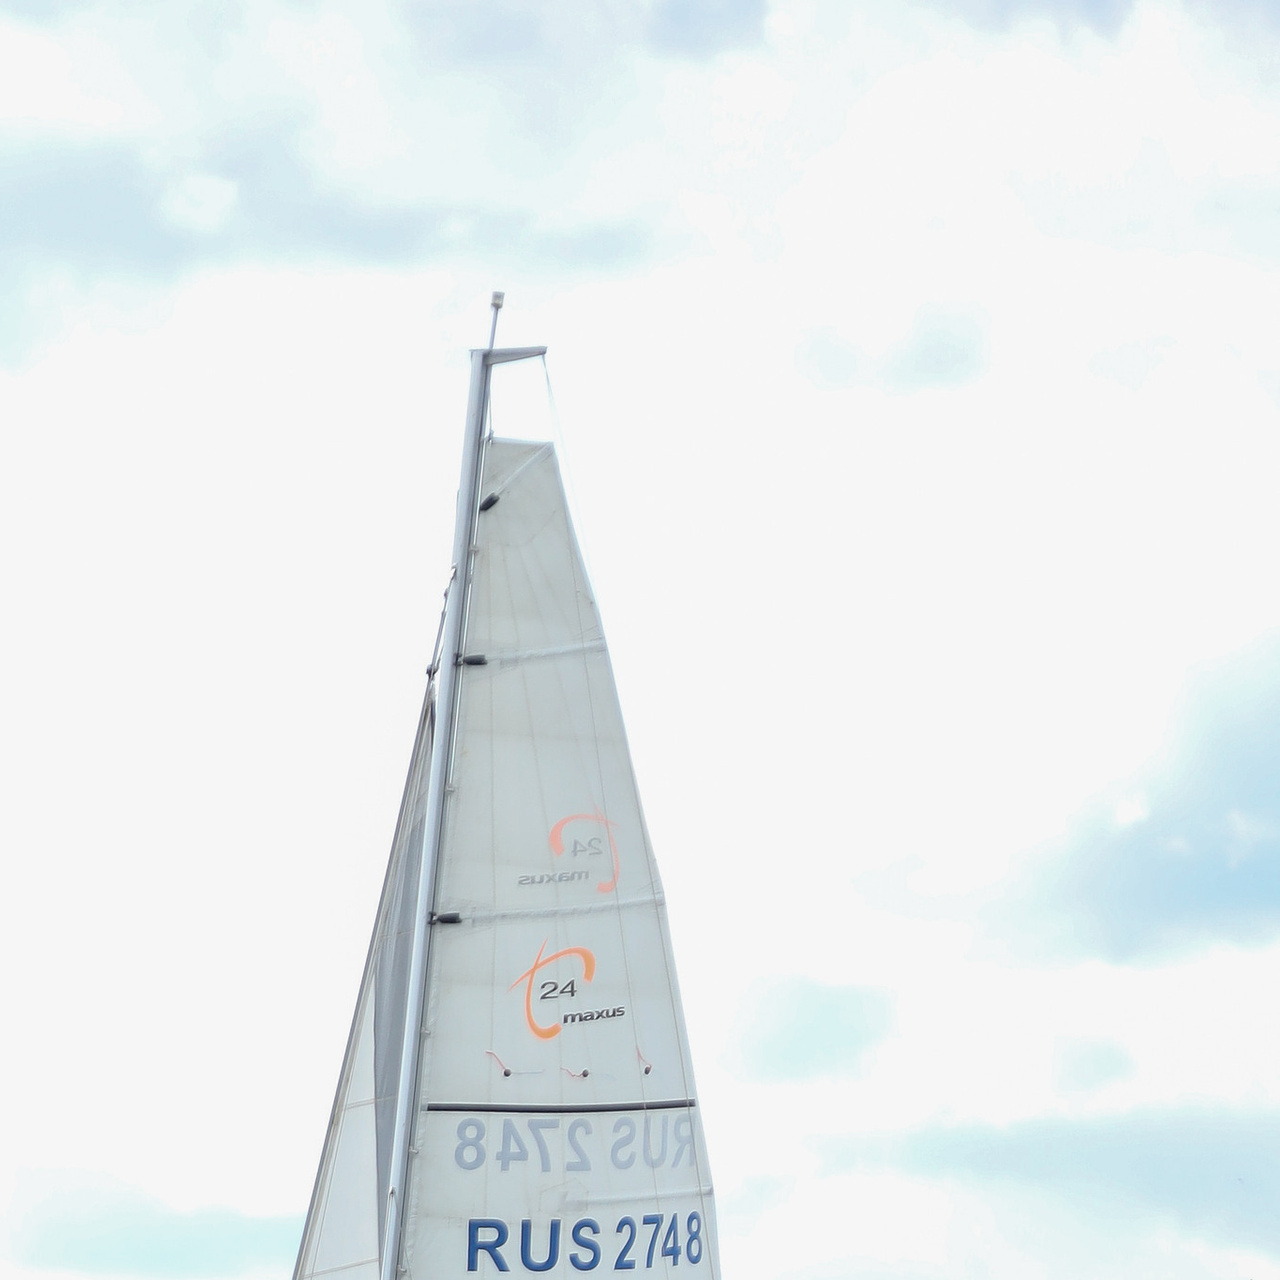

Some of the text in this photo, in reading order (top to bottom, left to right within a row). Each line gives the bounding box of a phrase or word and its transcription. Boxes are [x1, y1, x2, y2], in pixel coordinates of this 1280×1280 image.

[539, 978, 578, 1001] 24
[562, 1005, 626, 1024] maxus
[467, 1210, 704, 1272] RUS 2748
